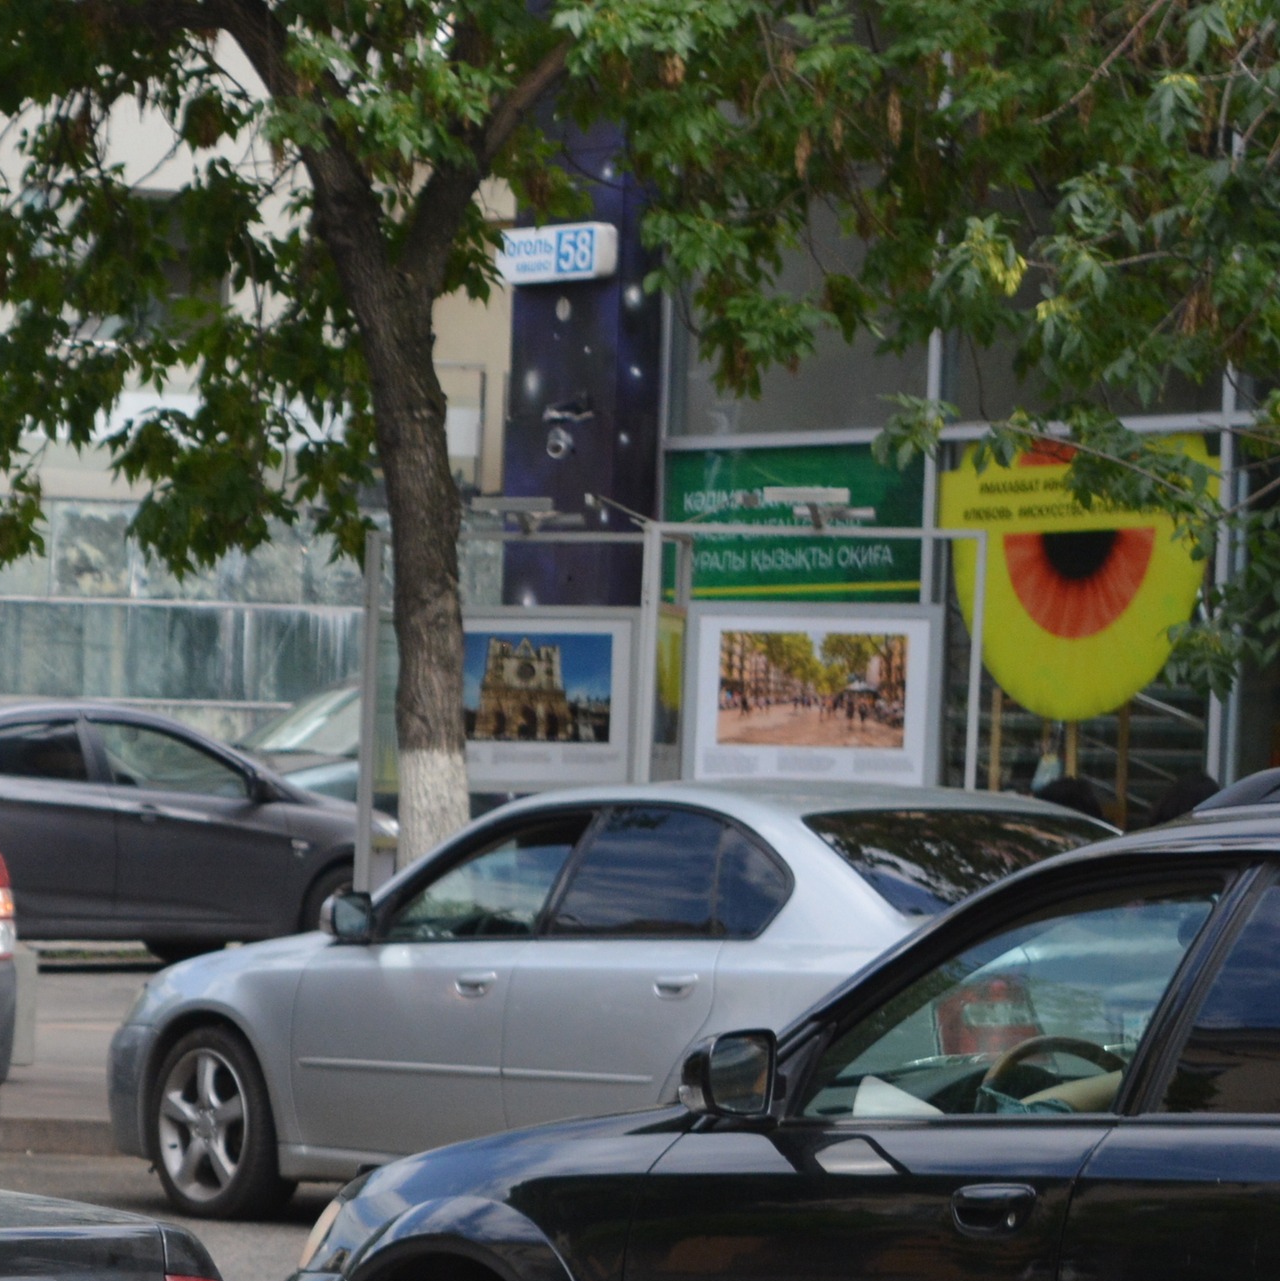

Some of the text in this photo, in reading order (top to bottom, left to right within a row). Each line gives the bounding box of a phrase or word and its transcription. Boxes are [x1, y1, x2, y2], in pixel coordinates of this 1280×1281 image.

[502, 230, 593, 272] оголь 58
[690, 547, 746, 572] УРАЛЫ
